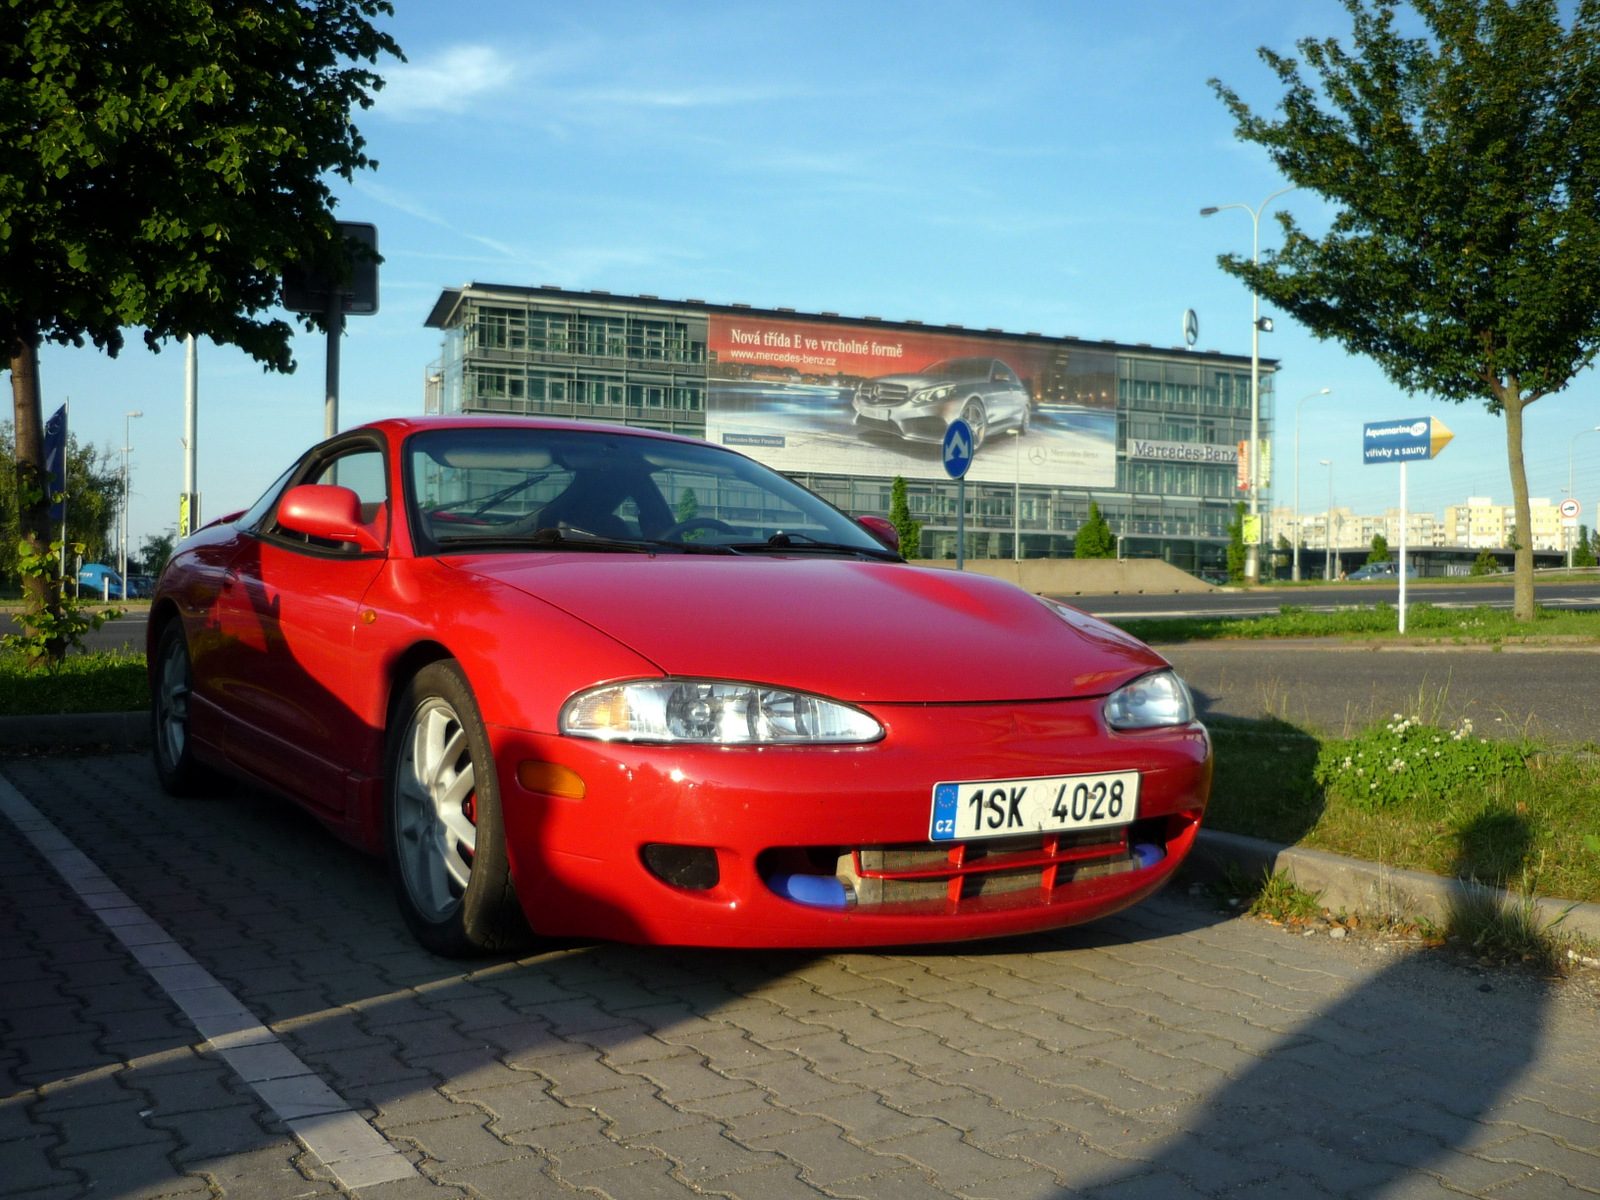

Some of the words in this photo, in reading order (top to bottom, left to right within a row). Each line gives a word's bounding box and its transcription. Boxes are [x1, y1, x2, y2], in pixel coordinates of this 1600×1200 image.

[731, 328, 760, 346] Nová
[764, 331, 791, 348] třída
[794, 334, 802, 349] E
[804, 338, 818, 350] ve
[821, 338, 869, 355] vrcholné
[871, 341, 903, 358] formě
[730, 349, 837, 366] www.mercedes-benz.cz
[1365, 425, 1411, 438] Aquamarine
[1133, 441, 1237, 462] Mercedes-Benz
[1401, 446, 1427, 455] sauny
[969, 786, 1027, 830] 1SK
[1052, 779, 1124, 823] 4028
[935, 819, 952, 833] CZ
